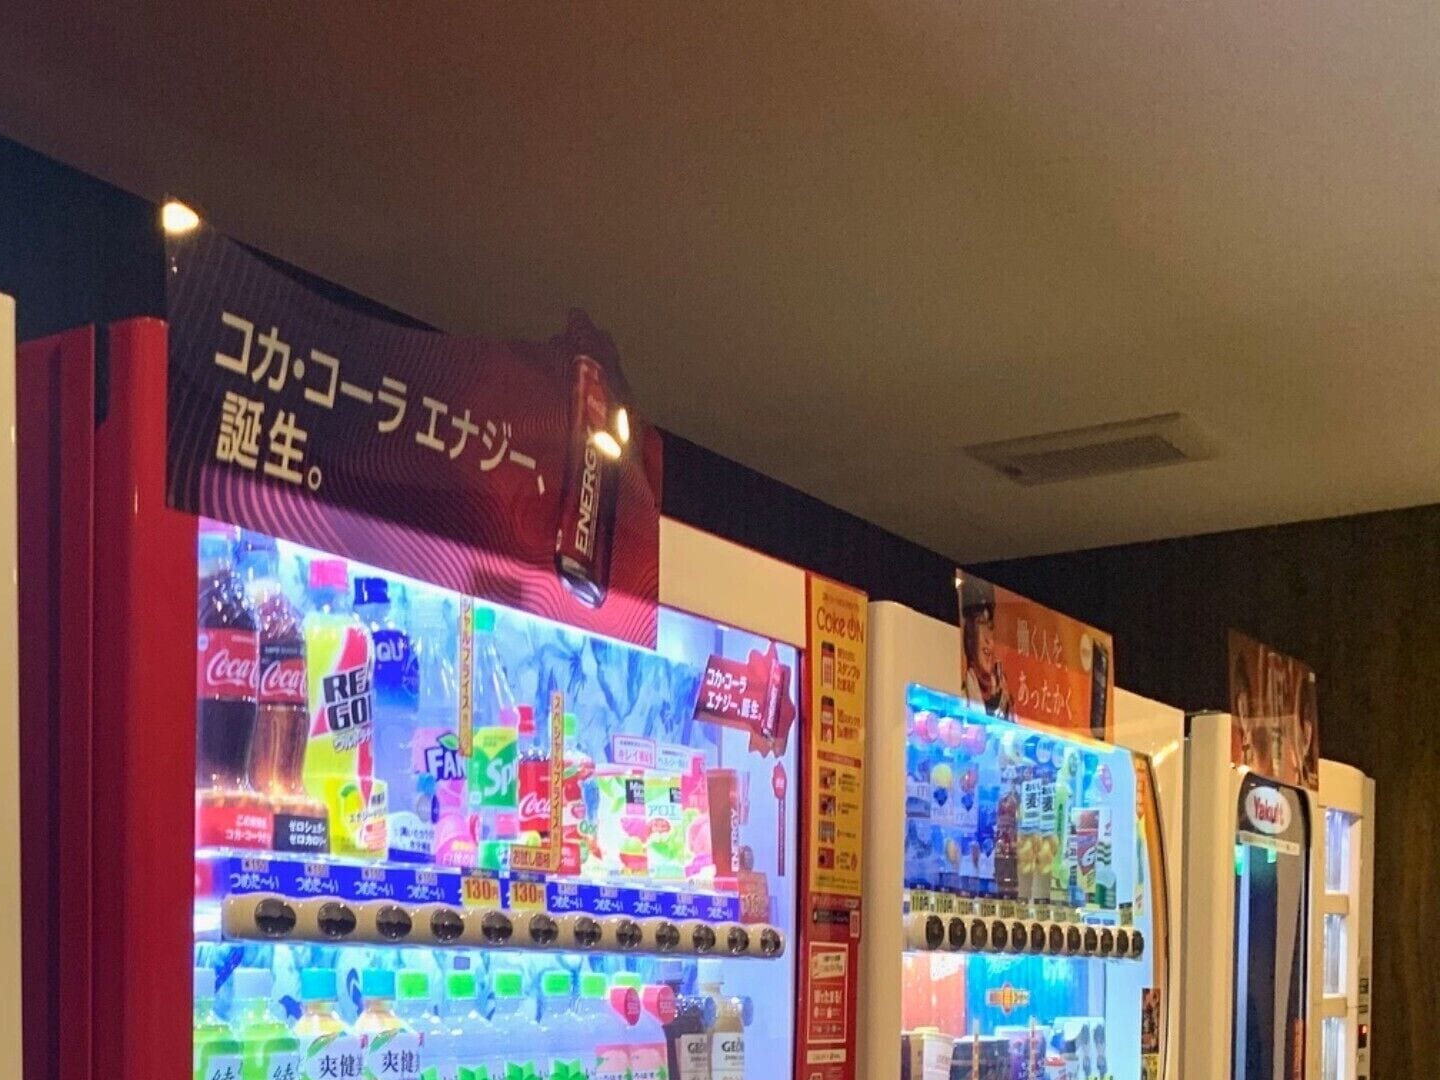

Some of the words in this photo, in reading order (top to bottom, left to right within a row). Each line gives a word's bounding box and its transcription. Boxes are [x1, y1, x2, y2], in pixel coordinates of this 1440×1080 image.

[215, 311, 407, 433] コカ・コーラ
[216, 390, 322, 490] 誕生。
[706, 668, 748, 693] コカ・コーラ
[1017, 675, 1075, 721] あったかく
[229, 872, 280, 890] つめた～い
[295, 876, 339, 895] つめた～い
